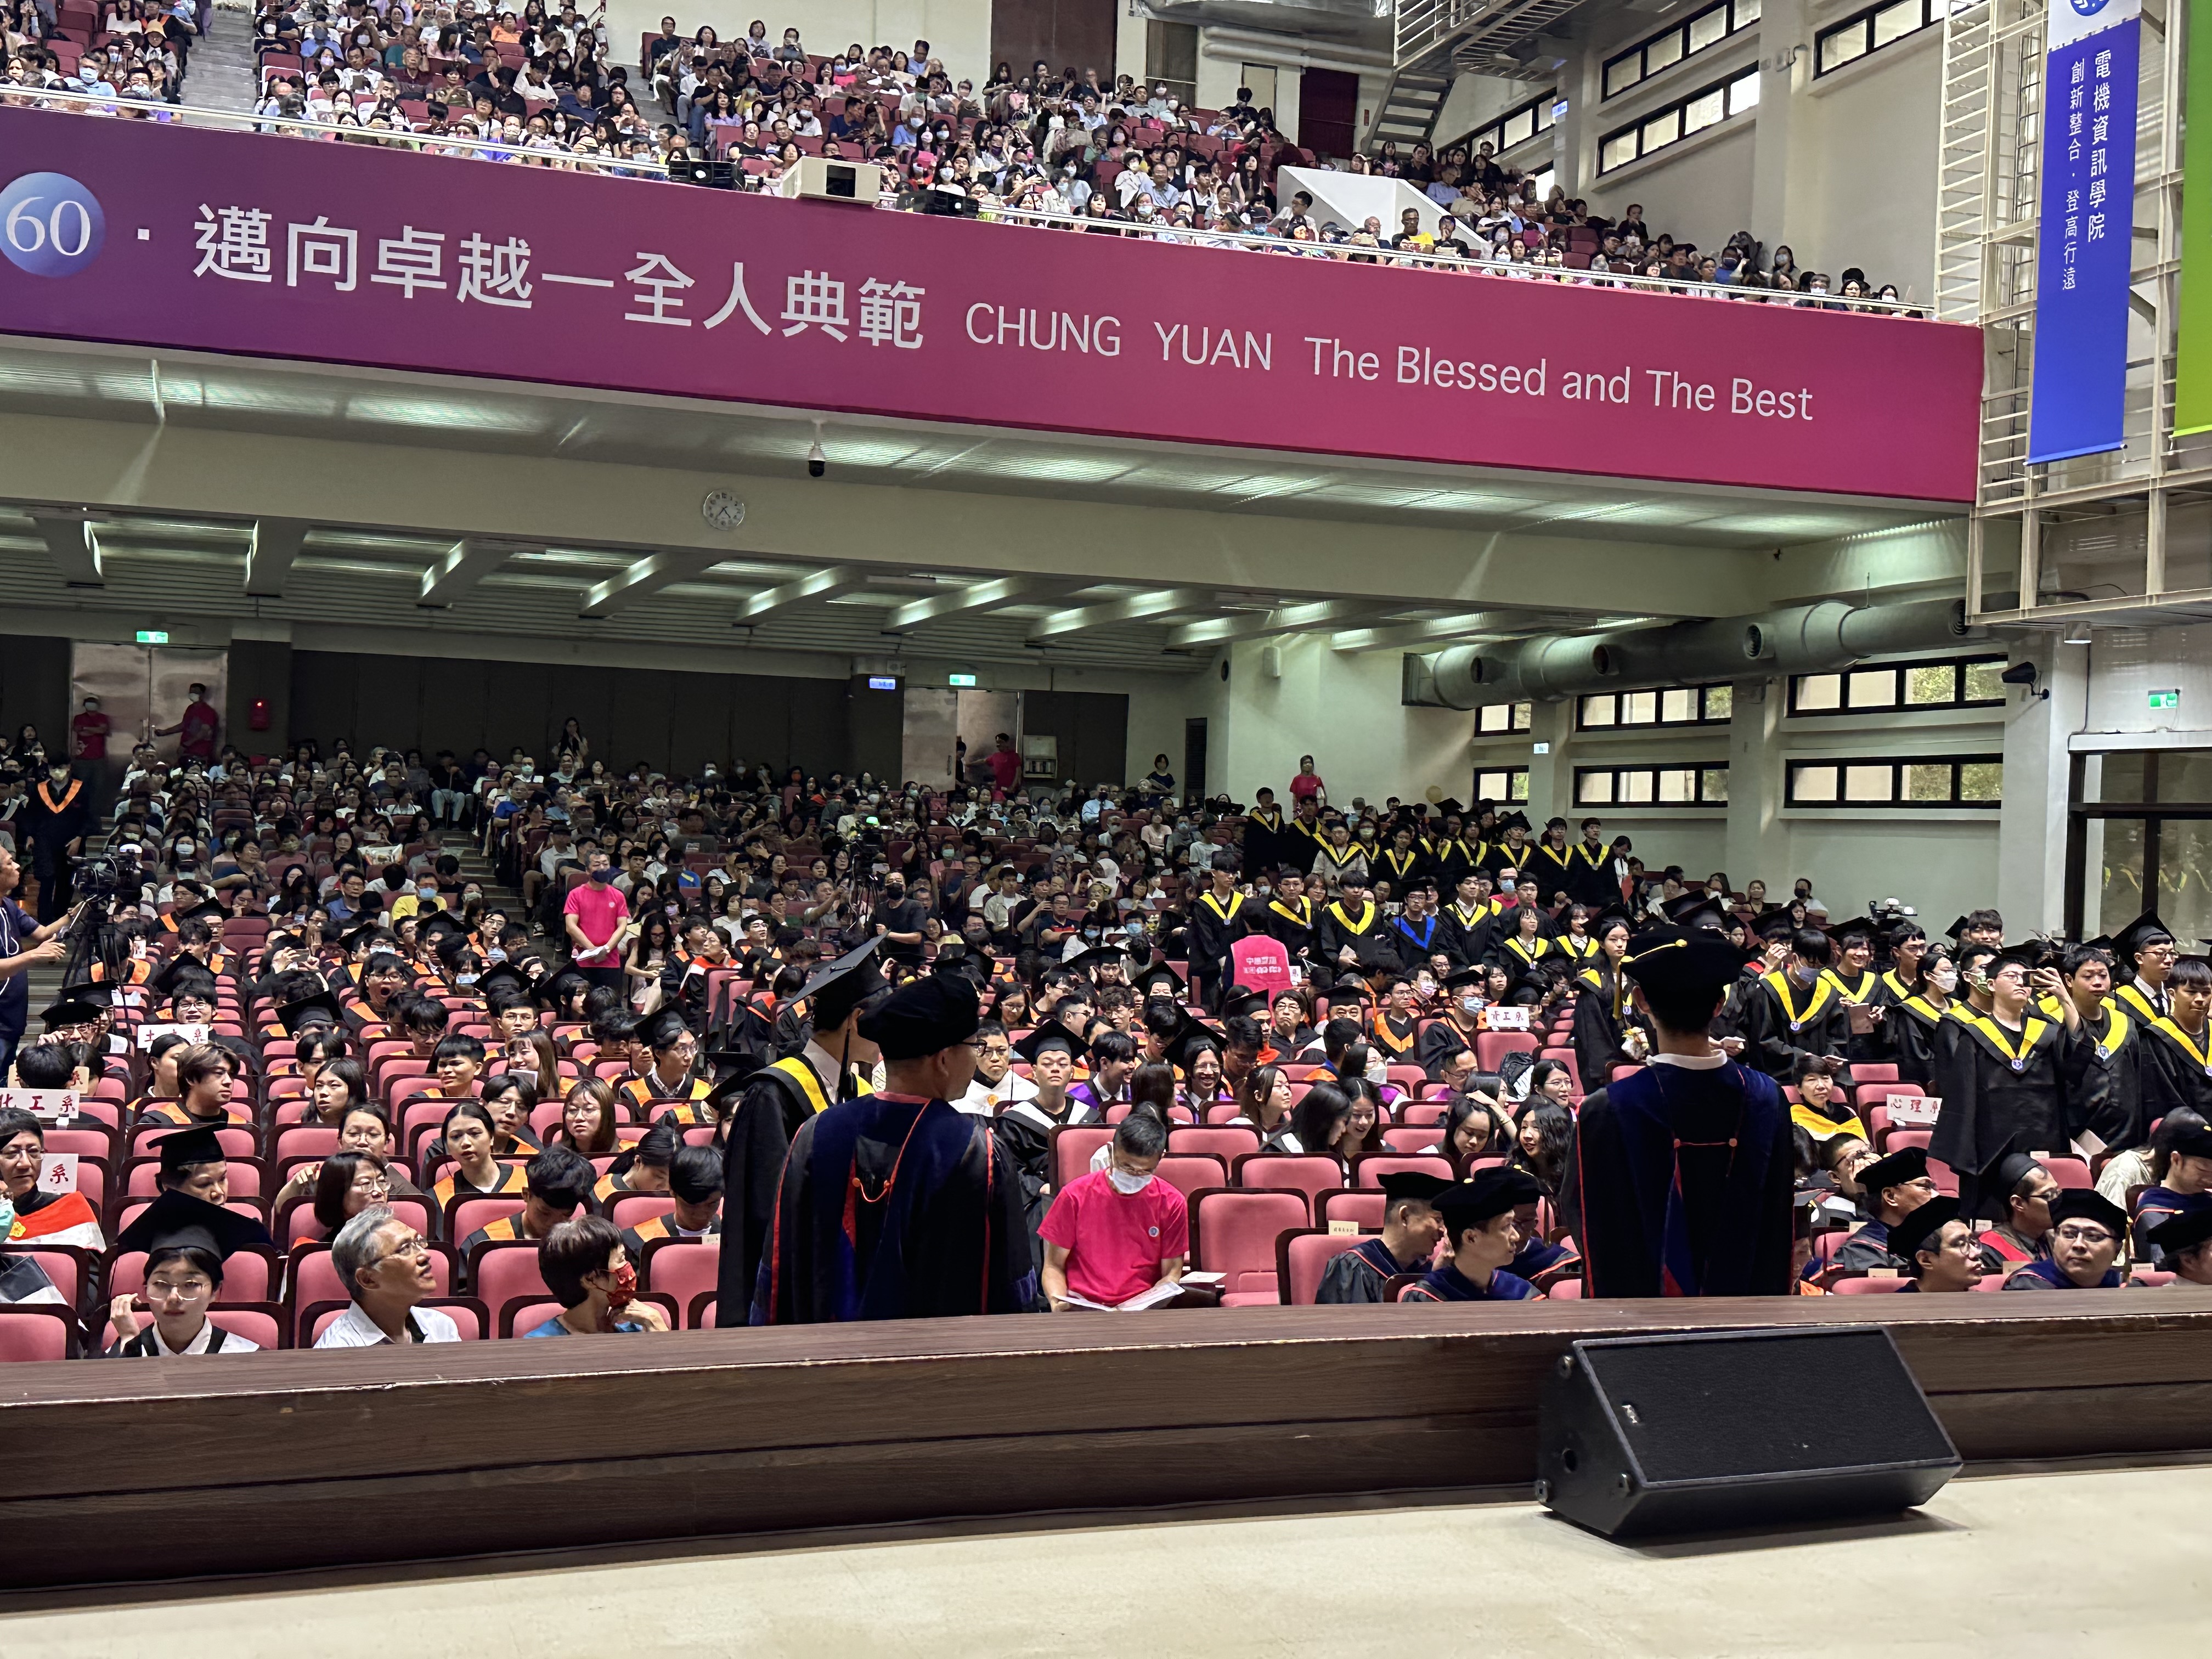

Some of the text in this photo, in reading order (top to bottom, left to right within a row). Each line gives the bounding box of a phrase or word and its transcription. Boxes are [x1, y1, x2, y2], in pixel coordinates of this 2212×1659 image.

[2086, 49, 2112, 242] 電機資訊學院
[5, 196, 91, 257] 60
[966, 302, 1814, 421] CHUNG YUAN The Blessed and The Best
[144, 1029, 207, 1043] 土系
